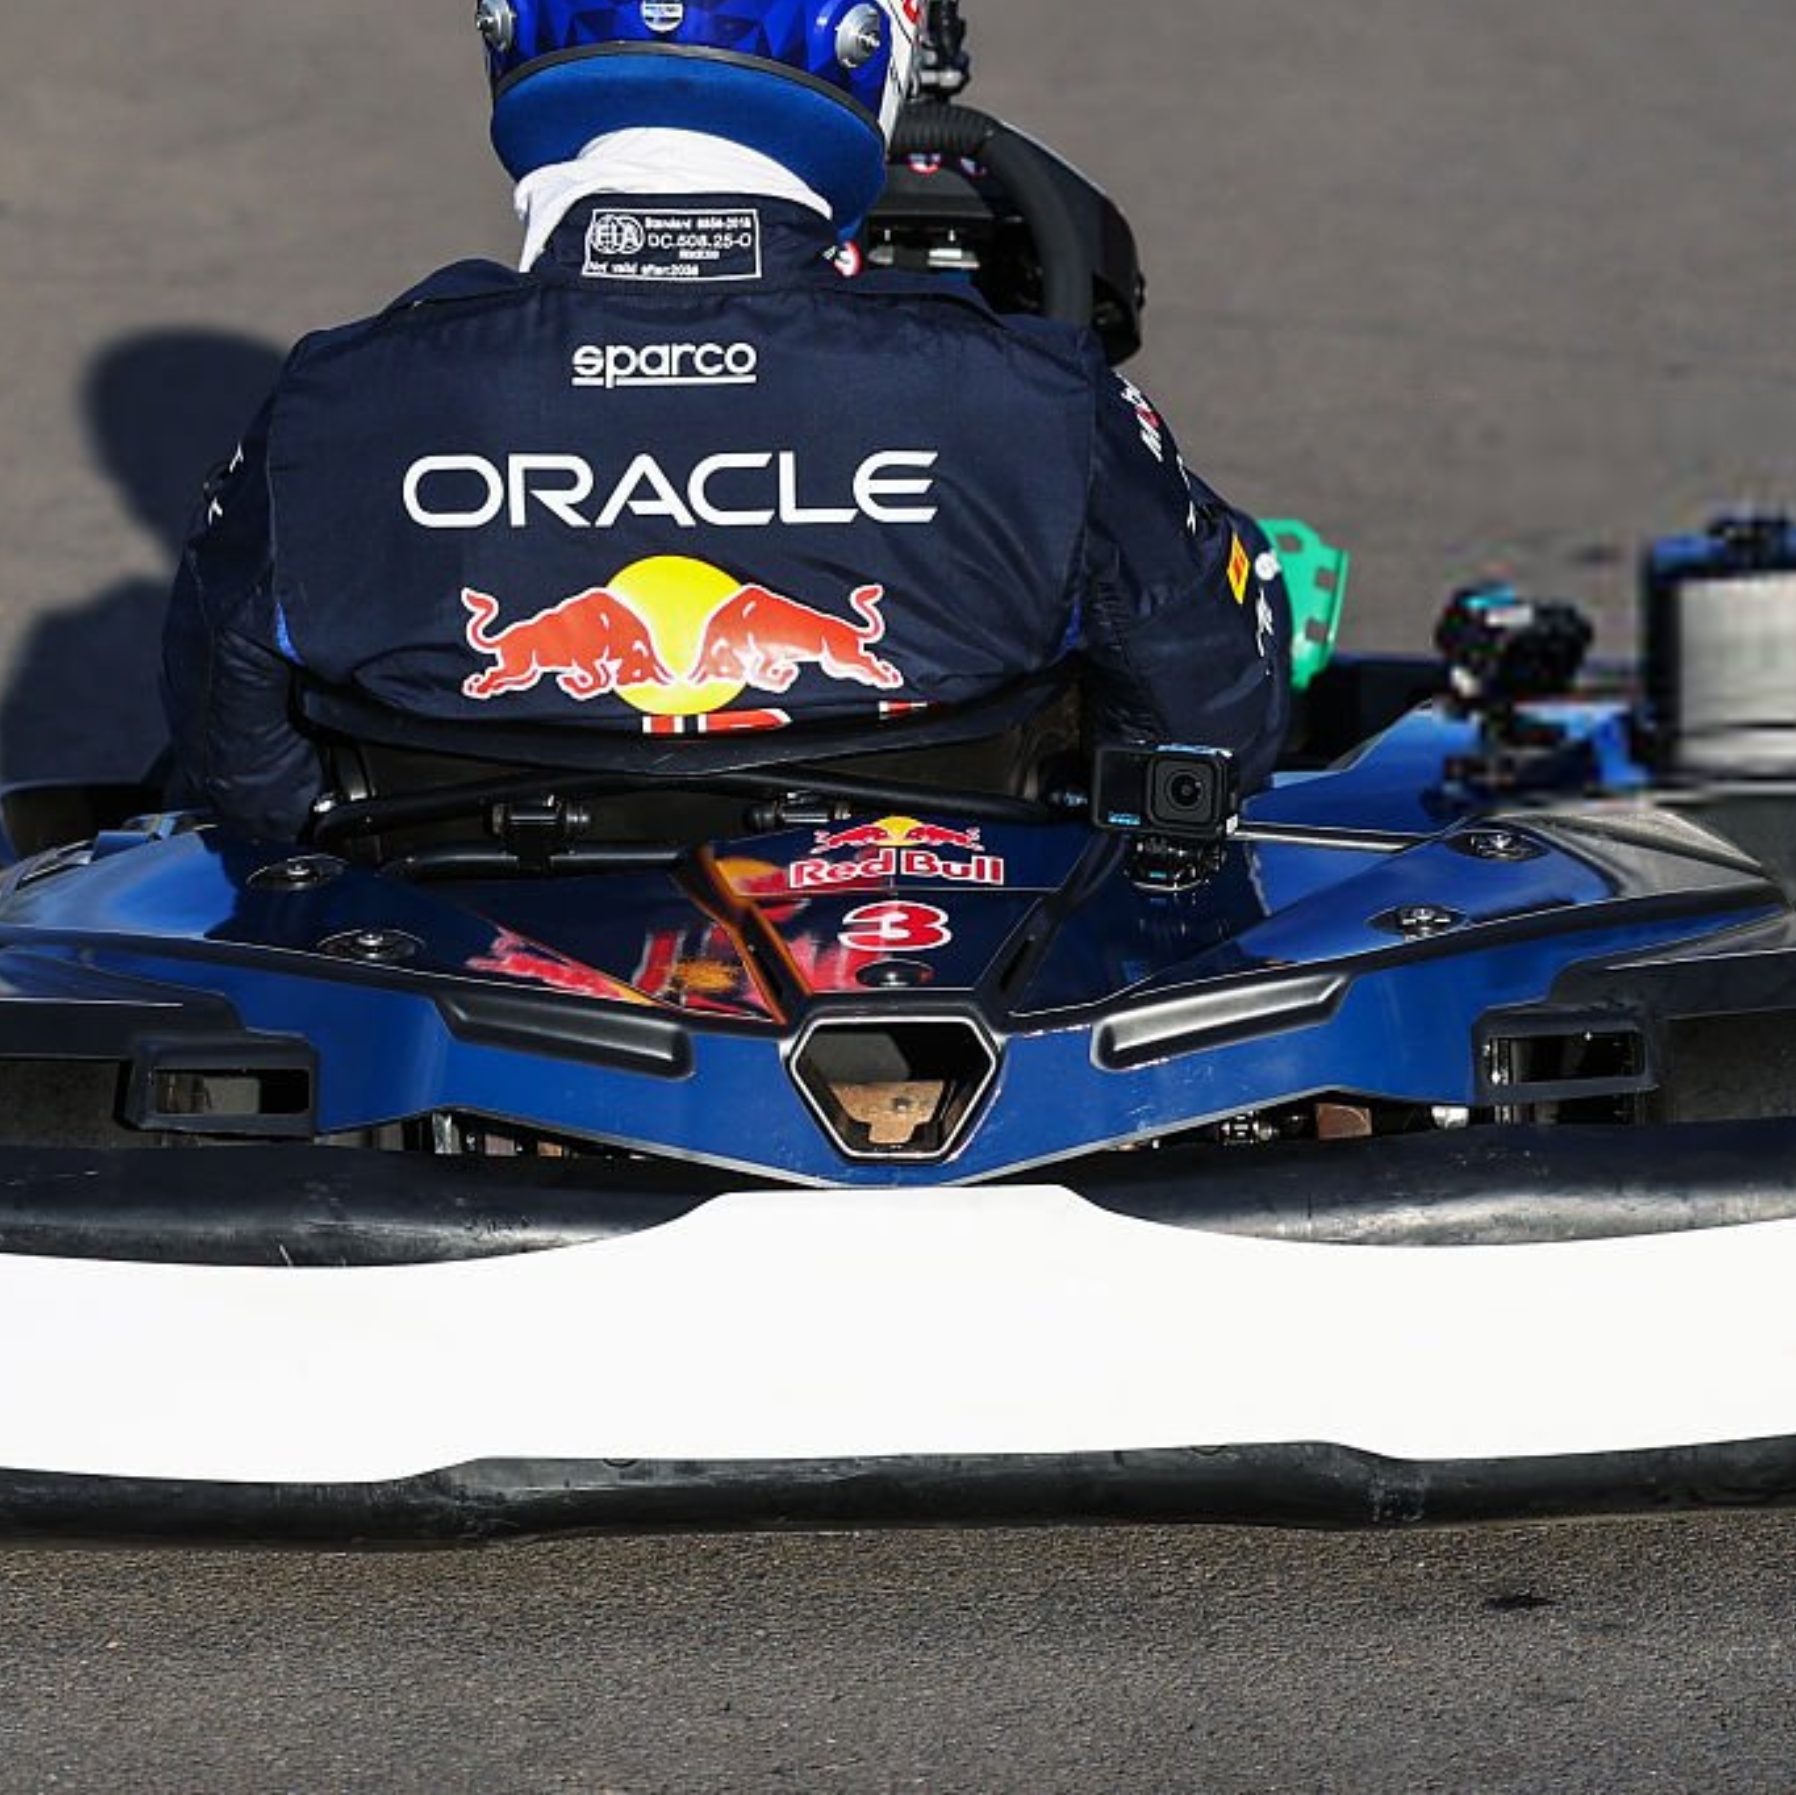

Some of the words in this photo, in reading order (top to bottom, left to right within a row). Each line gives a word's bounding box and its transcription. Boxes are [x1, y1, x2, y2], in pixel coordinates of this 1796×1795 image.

[593, 219, 641, 249] FIA
[572, 342, 756, 389] sparco
[402, 450, 939, 529] ORACLE
[789, 848, 896, 888] Red
[900, 849, 1004, 885] Bull
[837, 900, 952, 951] 3
